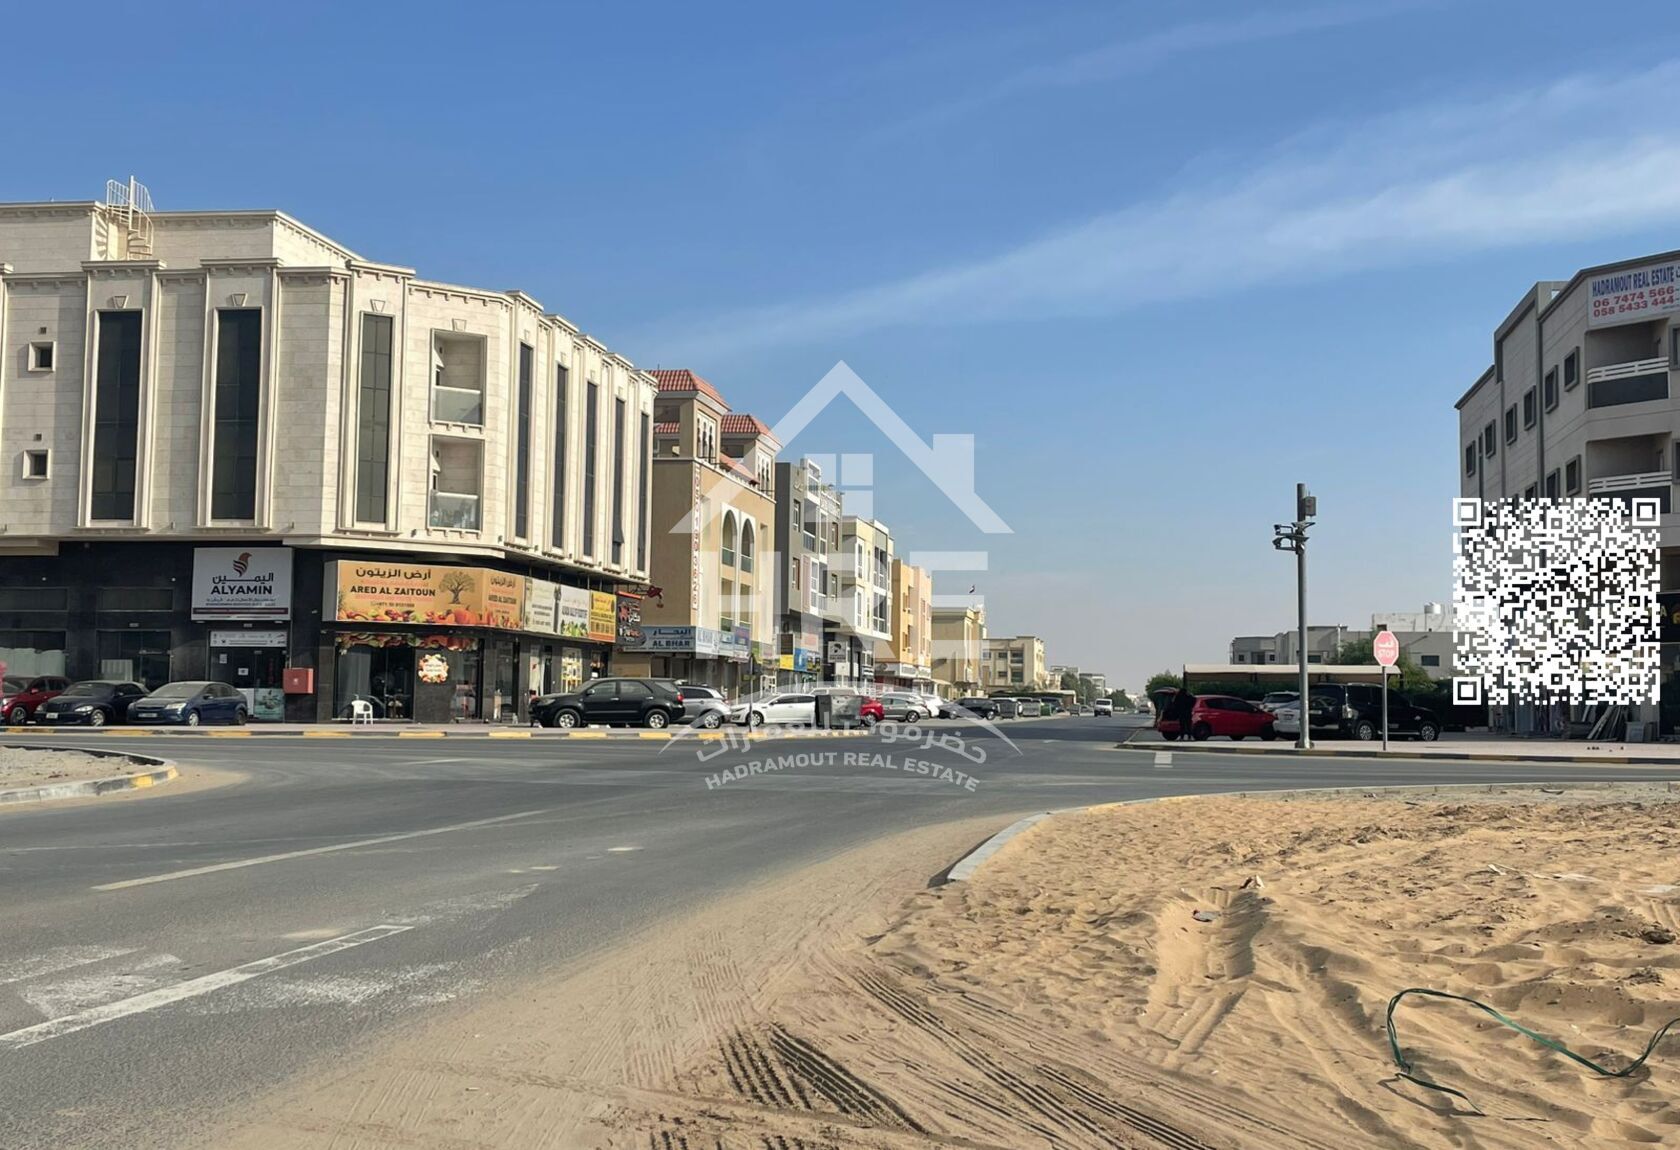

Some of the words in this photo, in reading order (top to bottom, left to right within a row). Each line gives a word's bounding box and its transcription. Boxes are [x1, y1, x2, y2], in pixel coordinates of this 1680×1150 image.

[1592, 275, 1632, 297] HADRAMOUT
[1633, 271, 1650, 289] REAL
[1651, 266, 1675, 287] ESTATE
[1593, 298, 1610, 308] 06
[1614, 291, 1645, 305] 7474
[1619, 300, 1648, 313] 5433
[355, 567, 401, 578] الزيتون
[403, 568, 432, 580] أرض
[211, 585, 273, 595] ALYAMIN
[350, 585, 377, 594] ARED
[379, 586, 393, 595] AL
[394, 588, 436, 597] ZAITOUN
